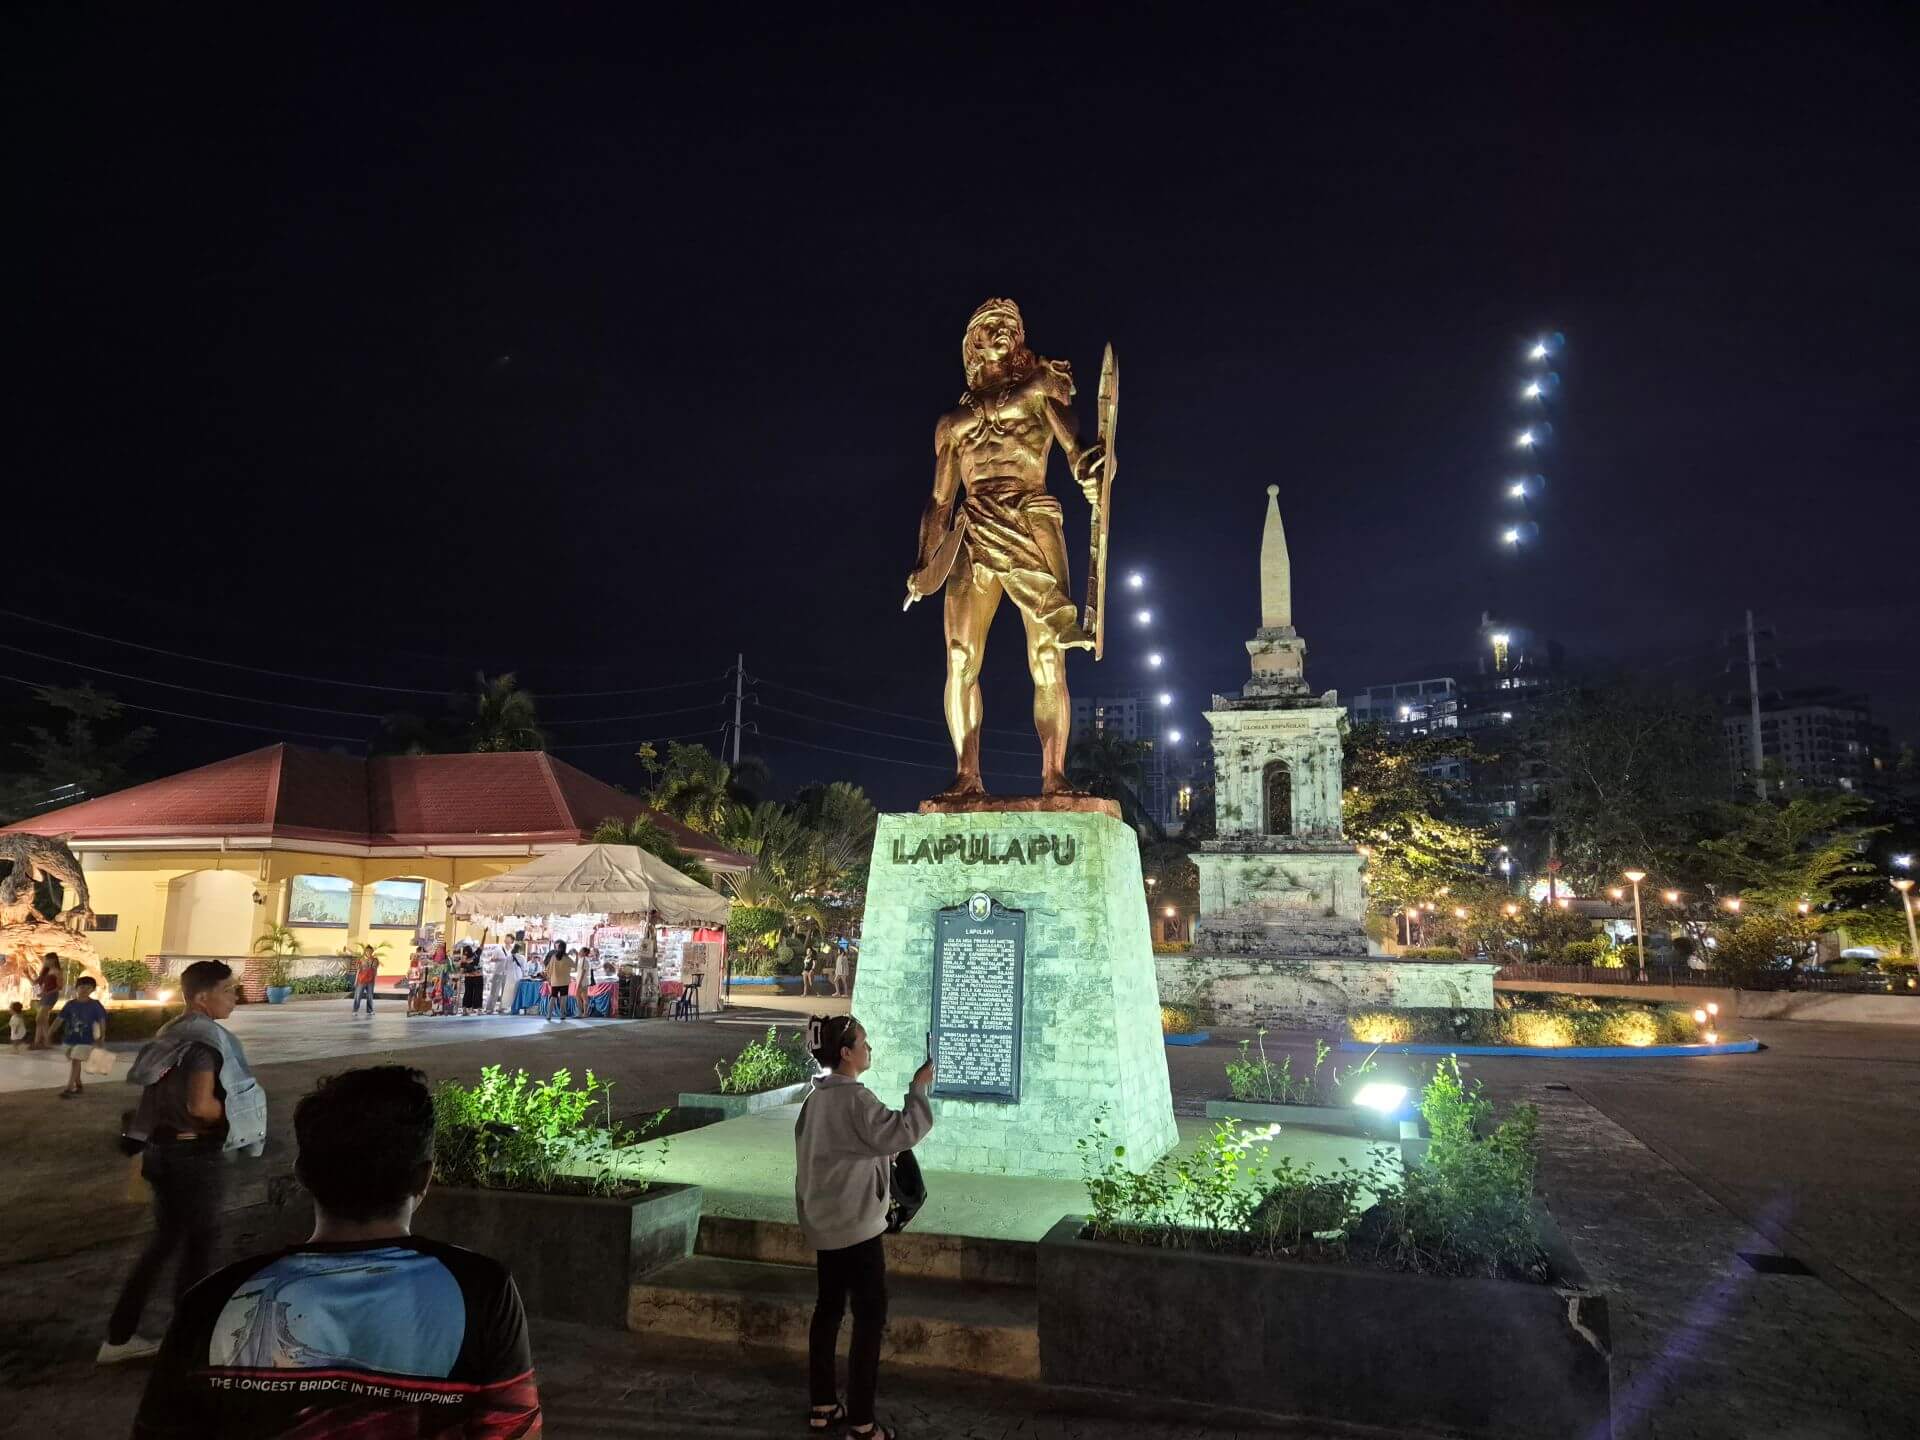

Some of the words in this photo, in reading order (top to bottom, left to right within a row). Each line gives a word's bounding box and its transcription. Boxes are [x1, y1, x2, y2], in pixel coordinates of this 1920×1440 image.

[892, 834, 1076, 866] LAPULAPU
[209, 1376, 231, 1390] THE
[235, 1378, 296, 1393] LONGEST
[299, 1379, 348, 1393] BRIDGE
[350, 1382, 364, 1395] IN
[367, 1385, 391, 1399] THE
[394, 1390, 464, 1406] PHILIPPINES
